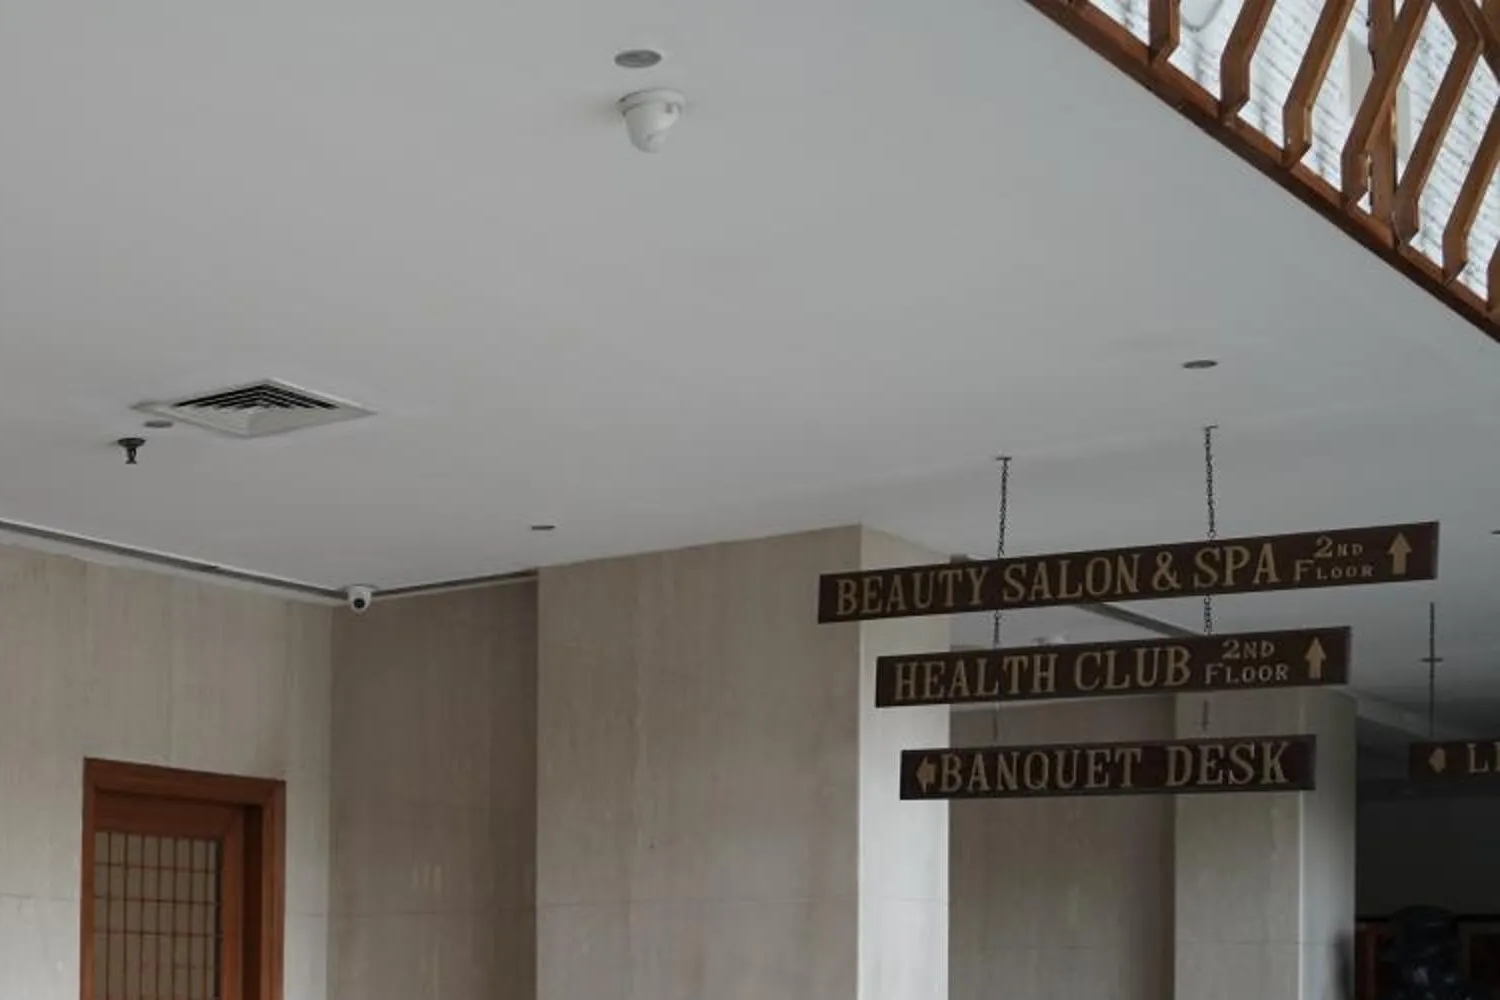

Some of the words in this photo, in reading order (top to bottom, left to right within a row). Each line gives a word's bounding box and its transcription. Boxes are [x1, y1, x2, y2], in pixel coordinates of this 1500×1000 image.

[1313, 535, 1364, 559] 2ND
[836, 566, 989, 615] BEAUTY
[1003, 554, 1143, 602] SALON
[1152, 551, 1182, 592] &
[1194, 542, 1280, 588] SPA
[1293, 558, 1374, 582] FLOOR
[1222, 639, 1276, 660] 2ND
[894, 653, 1059, 700] HEALTH
[1073, 645, 1192, 691] CLUB
[1204, 663, 1289, 685] FLOOR
[940, 747, 1143, 793] BANQUET
[1164, 740, 1292, 787] DESK
